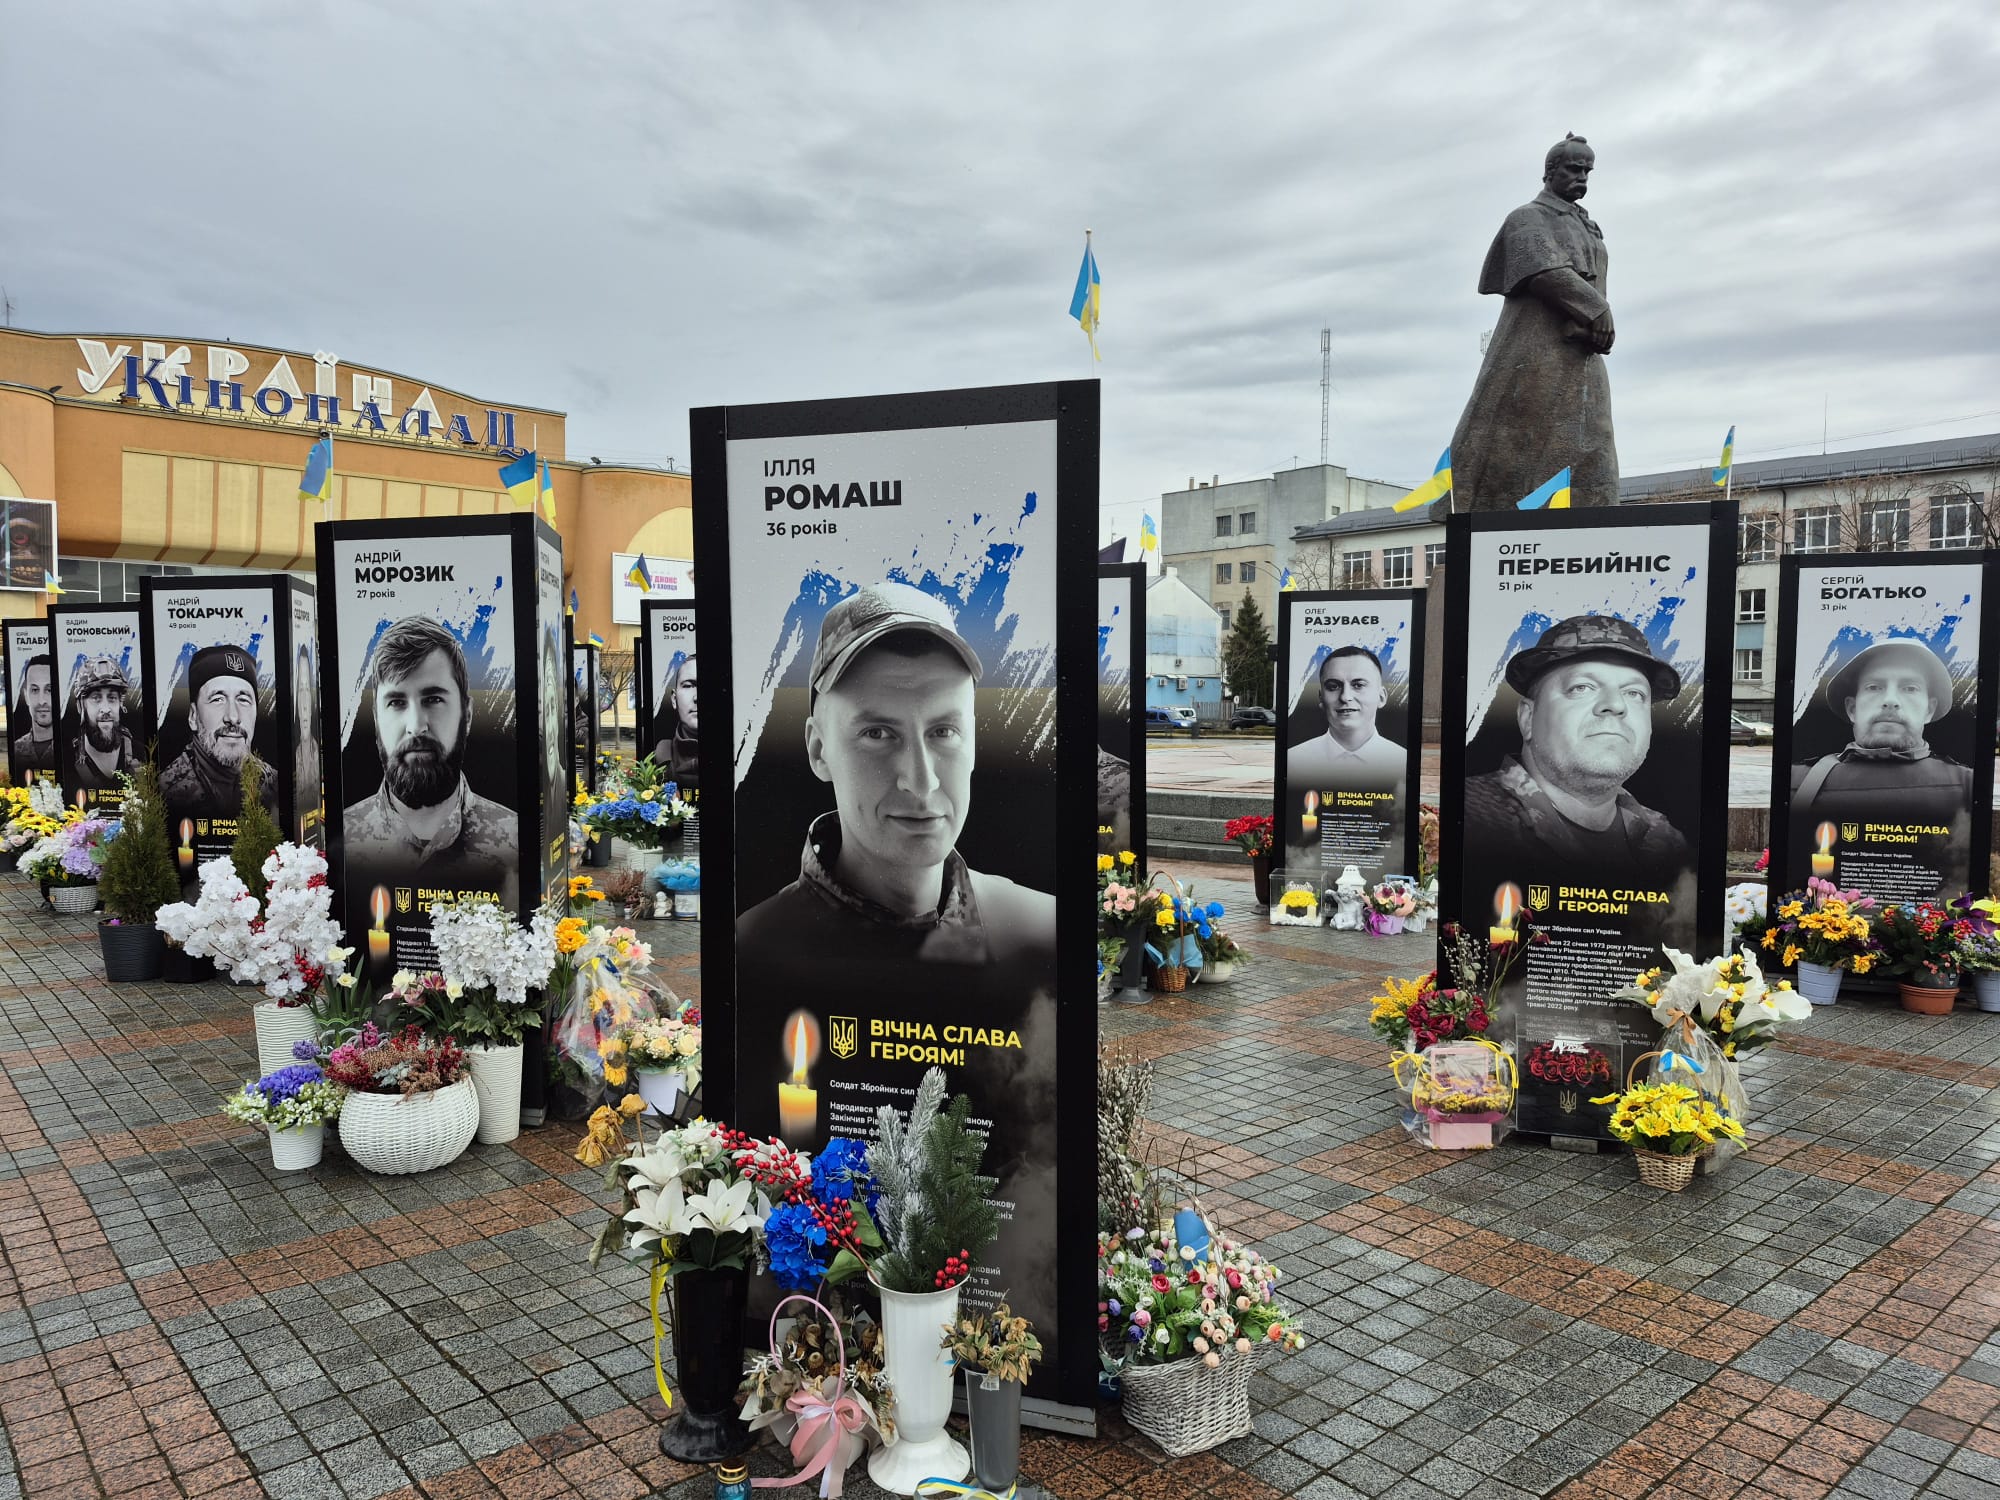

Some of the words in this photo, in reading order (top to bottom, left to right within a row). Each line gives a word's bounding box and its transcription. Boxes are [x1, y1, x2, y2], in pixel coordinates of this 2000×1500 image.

[76, 338, 444, 429] УКРАЇНА
[122, 355, 530, 460] КІНОПАЛАЦ
[764, 458, 815, 477] ІЛЛЯ
[764, 480, 902, 511] РОМАШ
[766, 522, 786, 536] 36
[791, 519, 837, 539] років
[1498, 543, 1542, 555] ОЛЕГ
[354, 549, 401, 565] АНДРІЙ
[1498, 551, 1671, 576] ПЕРЕБИЙНІС
[355, 565, 455, 584] МОРОЗИК
[1821, 574, 1864, 585] СЕРГІЙ
[1498, 581, 1510, 591] 51
[1514, 580, 1533, 592] рік
[356, 590, 368, 598] 27
[369, 589, 396, 600] років
[1821, 586, 1926, 600] БОГАТЬКО
[168, 596, 200, 606] АНДРІЙ
[1832, 602, 1847, 611] рік
[168, 607, 244, 619] ТОКАРЧУК
[1304, 616, 1379, 626] РАЗУВАЄВ
[66, 625, 131, 636] ОГОНОВСЬКИЙ
[663, 623, 696, 632] БОРО
[1313, 627, 1332, 635] років
[16, 637, 48, 645] ГАЛАБУ
[1337, 791, 1363, 799] ВІЧНА
[1337, 799, 1373, 807] ГЕРОЯМ!
[212, 819, 238, 827] ВІЧНА
[1865, 823, 1903, 833] ВІЧНА
[1906, 825, 1949, 835] СЛАВА
[212, 828, 241, 836] ГЕРОЯ
[1865, 834, 1918, 844] ГЕРОЯМ!
[1558, 886, 1608, 900] ВІЧНА
[1612, 889, 1670, 903] СЛАВА
[1558, 900, 1628, 915] ГЕРОЯМ!
[1527, 923, 1550, 931] Солдат
[1551, 925, 1581, 933] Збройних
[1613, 973, 1637, 981] кордон
[870, 1019, 937, 1041] ВІЧНА
[943, 1025, 1022, 1048] СЛАВА
[870, 1042, 965, 1066] ГЕРОЯМ!
[829, 1079, 859, 1090] Солдат
[860, 1081, 898, 1095] Збройних
[900, 1088, 915, 1096] сил
[829, 1101, 874, 1114] Народився
[964, 1117, 995, 1127] івному.
[829, 1112, 866, 1124] Закінчив
[830, 1125, 867, 1136] опанував
[958, 1298, 996, 1311] апрямку.
